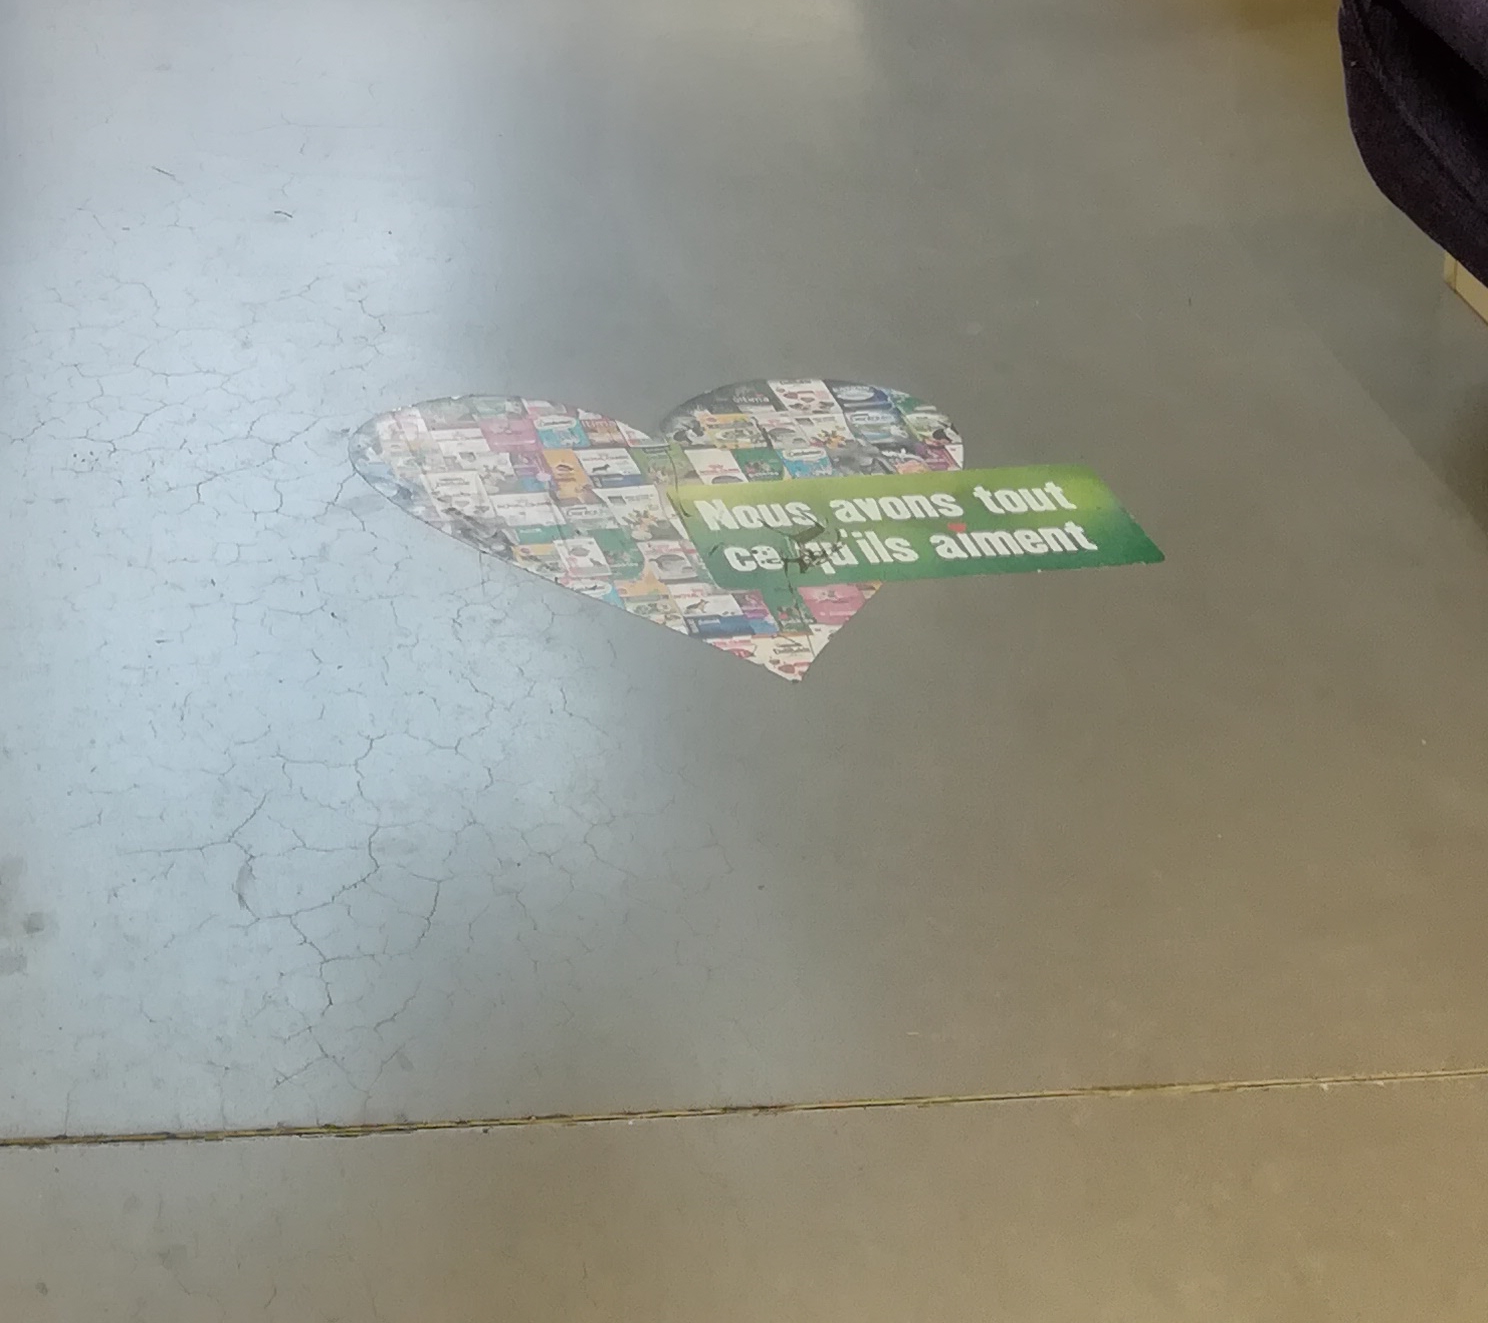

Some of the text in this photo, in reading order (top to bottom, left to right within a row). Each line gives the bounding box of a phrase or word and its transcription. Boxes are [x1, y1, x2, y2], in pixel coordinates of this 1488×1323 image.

[695, 481, 1078, 532] Nous avons tout
[724, 542, 784, 573] ce
[929, 521, 1098, 561] aiment
